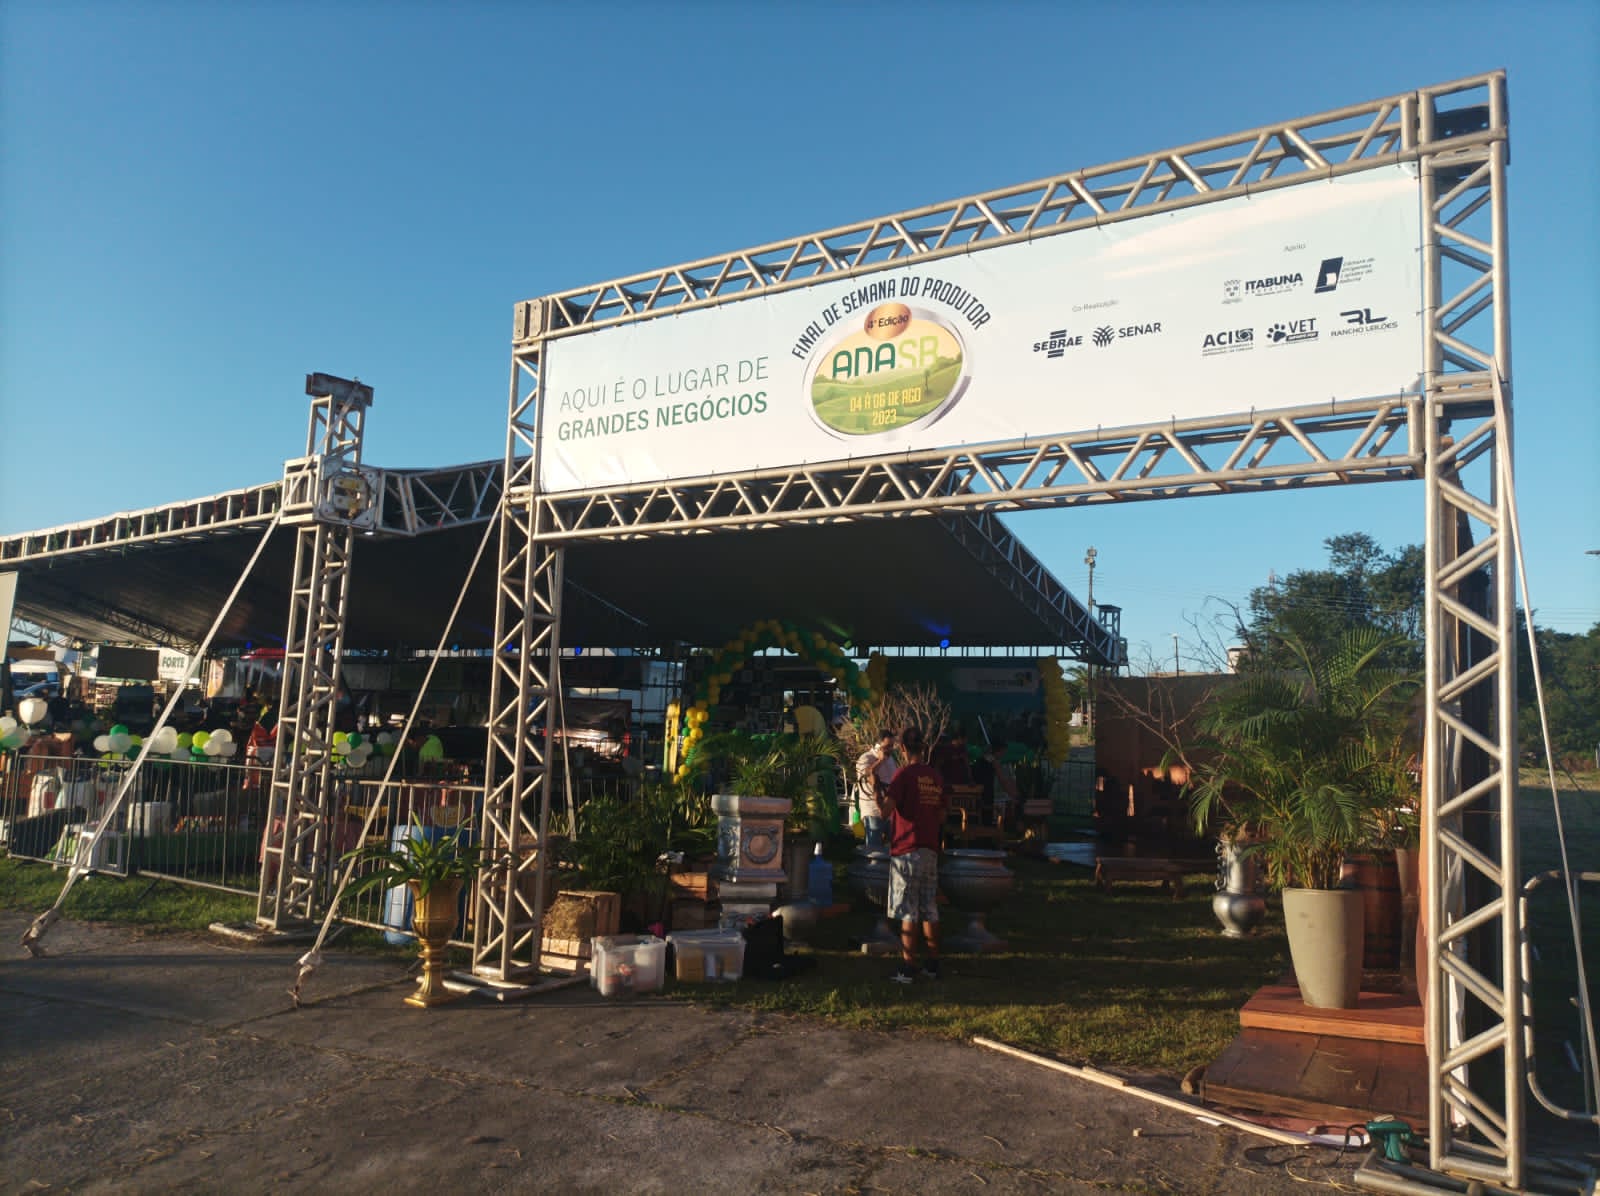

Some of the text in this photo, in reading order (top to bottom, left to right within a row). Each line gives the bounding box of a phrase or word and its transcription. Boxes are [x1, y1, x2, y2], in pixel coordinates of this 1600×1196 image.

[1245, 272, 1303, 291] ITABUNA
[792, 276, 991, 360] FINAL DE SEMANA DO PRODUTOR
[878, 314, 909, 328] Edição
[1288, 317, 1317, 333] VET
[1339, 307, 1388, 325] RL
[1118, 322, 1161, 338] SENAR
[1330, 327, 1364, 337] RANCHO
[1032, 336, 1083, 352] SEBRAE
[560, 356, 769, 413] AQUI É O LUGAR DE
[850, 396, 862, 412] 04
[873, 392, 886, 409] 06
[888, 390, 899, 406] DE
[902, 387, 921, 404] AGO
[558, 391, 768, 441] GRANDES NEGÓCIOS
[872, 408, 897, 426] 2023
[161, 656, 185, 669] FORTE
